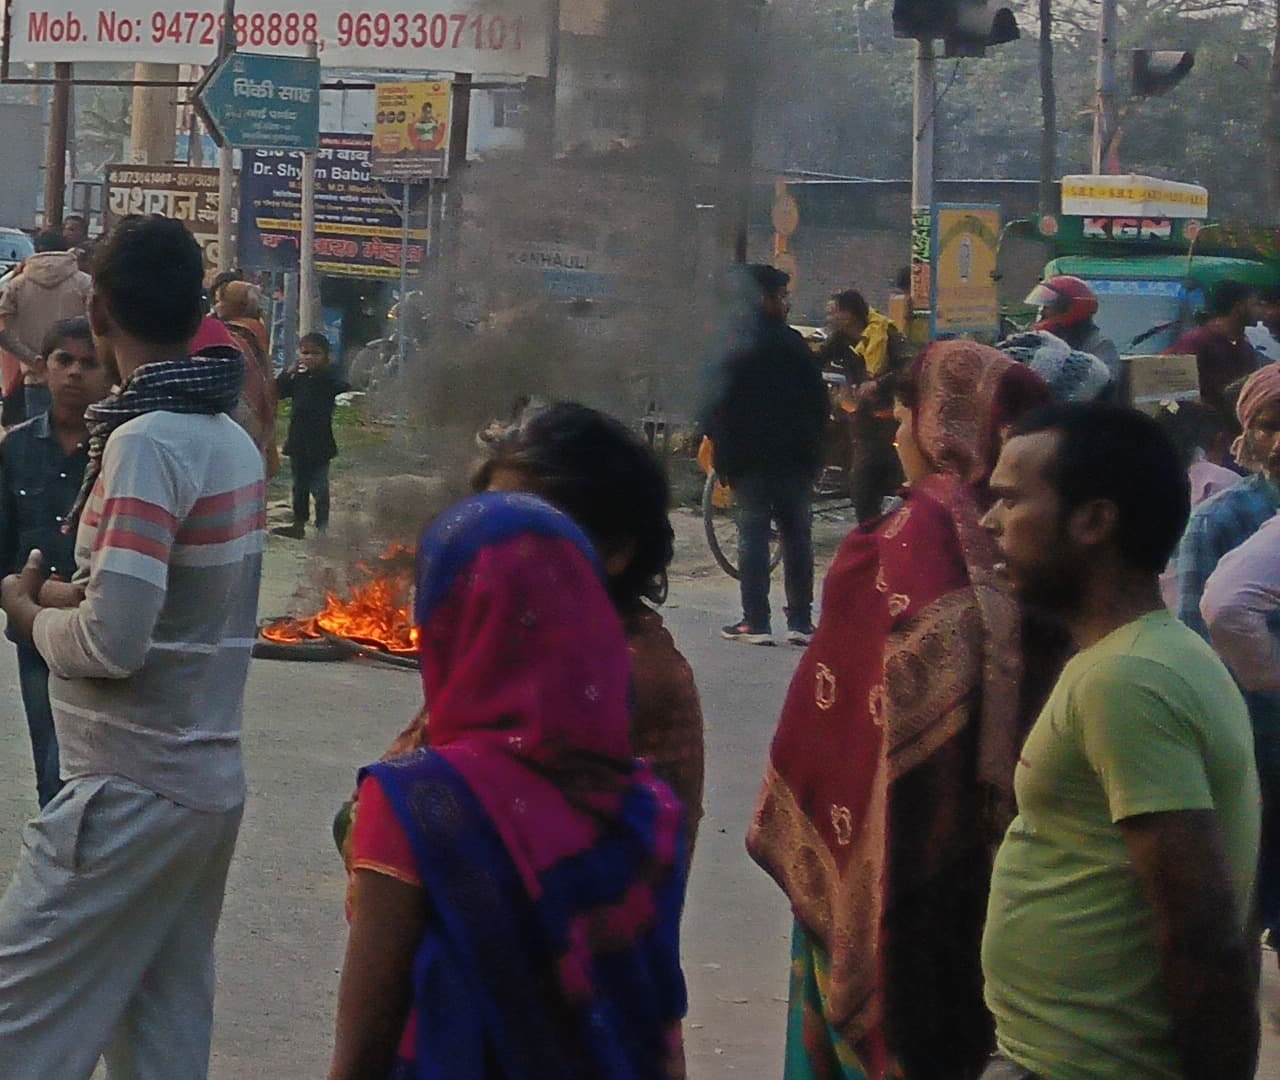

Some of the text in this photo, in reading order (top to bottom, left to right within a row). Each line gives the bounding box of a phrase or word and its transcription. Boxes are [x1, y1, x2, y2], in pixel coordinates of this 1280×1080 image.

[28, 11, 88, 43] Mob.
[97, 10, 142, 43] No:
[253, 161, 273, 176] Dr.
[277, 163, 327, 181] Shym
[331, 166, 370, 182] Babu
[506, 249, 590, 270] ANHAULI
